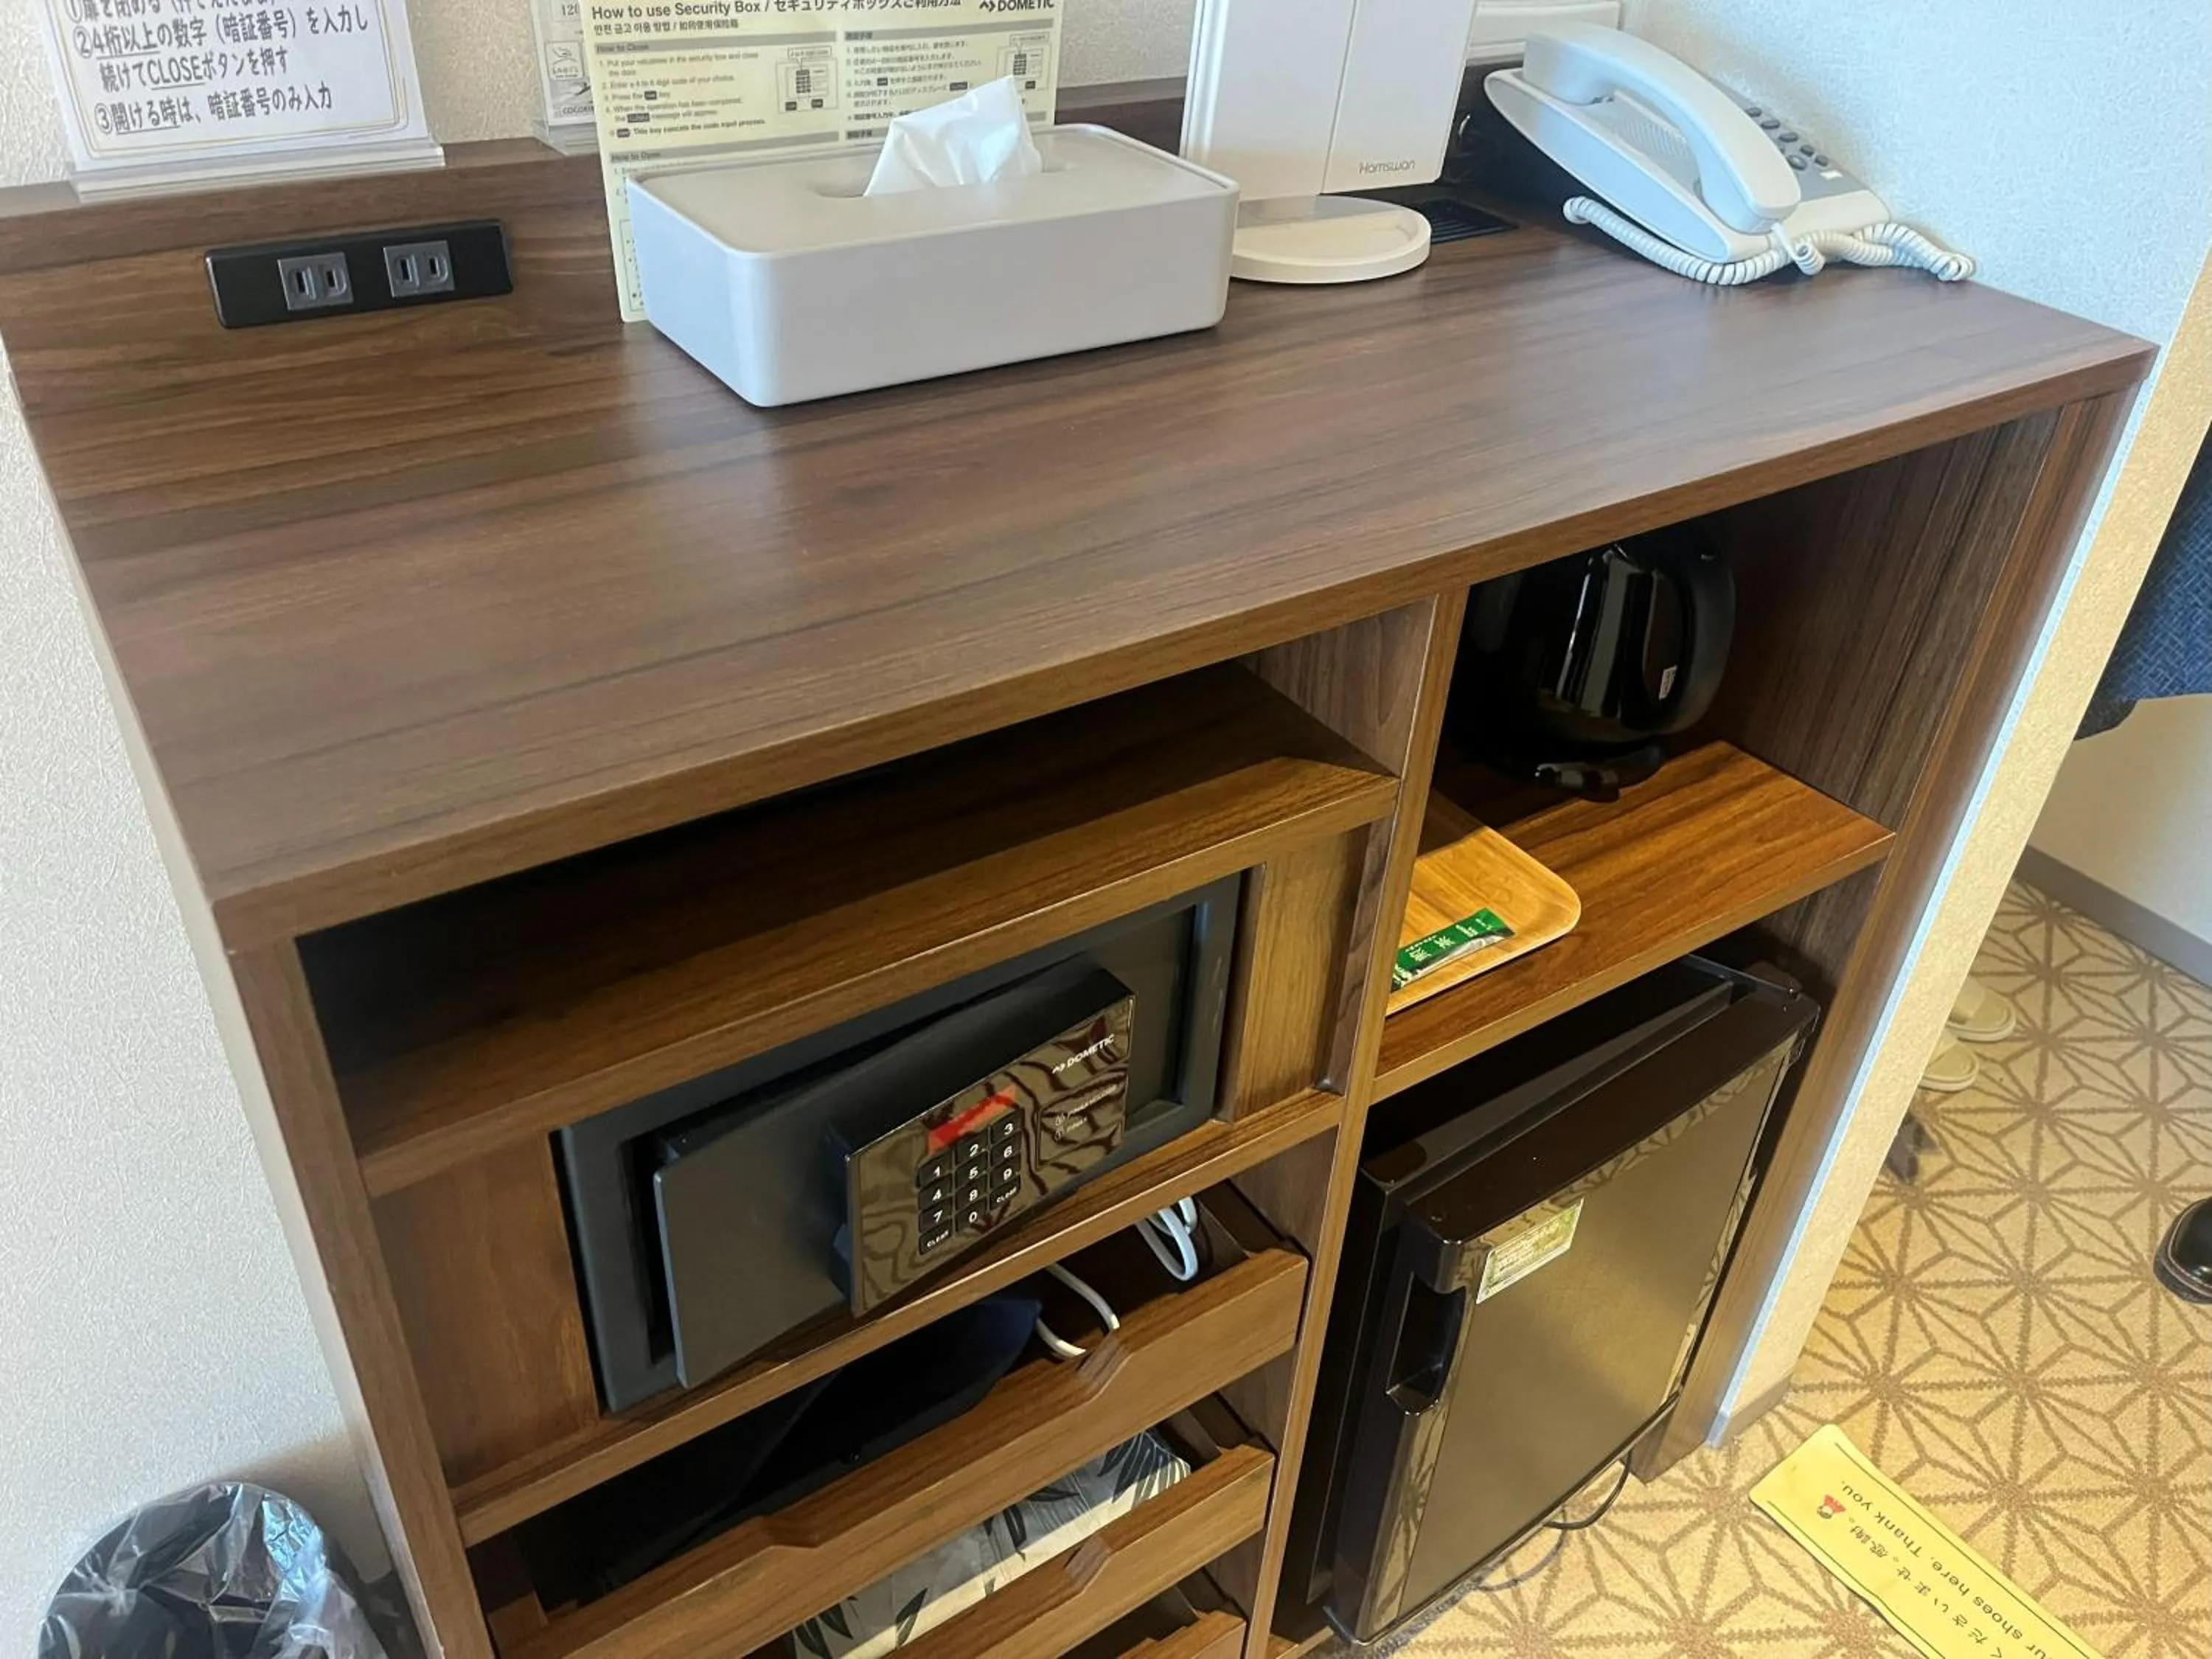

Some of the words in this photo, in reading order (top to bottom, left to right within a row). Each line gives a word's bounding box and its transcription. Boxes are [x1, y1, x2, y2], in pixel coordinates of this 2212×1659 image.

[592, 6, 623, 19] How
[627, 5, 641, 18] to
[646, 6, 670, 17] use
[675, 1, 730, 16] Security
[734, 1, 760, 13] Box
[1066, 1033, 1116, 1068] DOMETIC
[1004, 1122, 1014, 1135] 3
[969, 1144, 979, 1157] 2
[1004, 1145, 1013, 1158] 6
[933, 1166, 941, 1178] 1
[969, 1166, 979, 1180] 5
[931, 1189, 942, 1201] 4
[969, 1189, 978, 1202] 8
[933, 1209, 943, 1223] 7
[968, 1211, 978, 1224] 0
[1842, 1481, 1874, 1511] you.
[1875, 1511, 1922, 1558] Thank
[1930, 1557, 1970, 1596] here.
[1972, 1596, 2023, 1640] shoes
